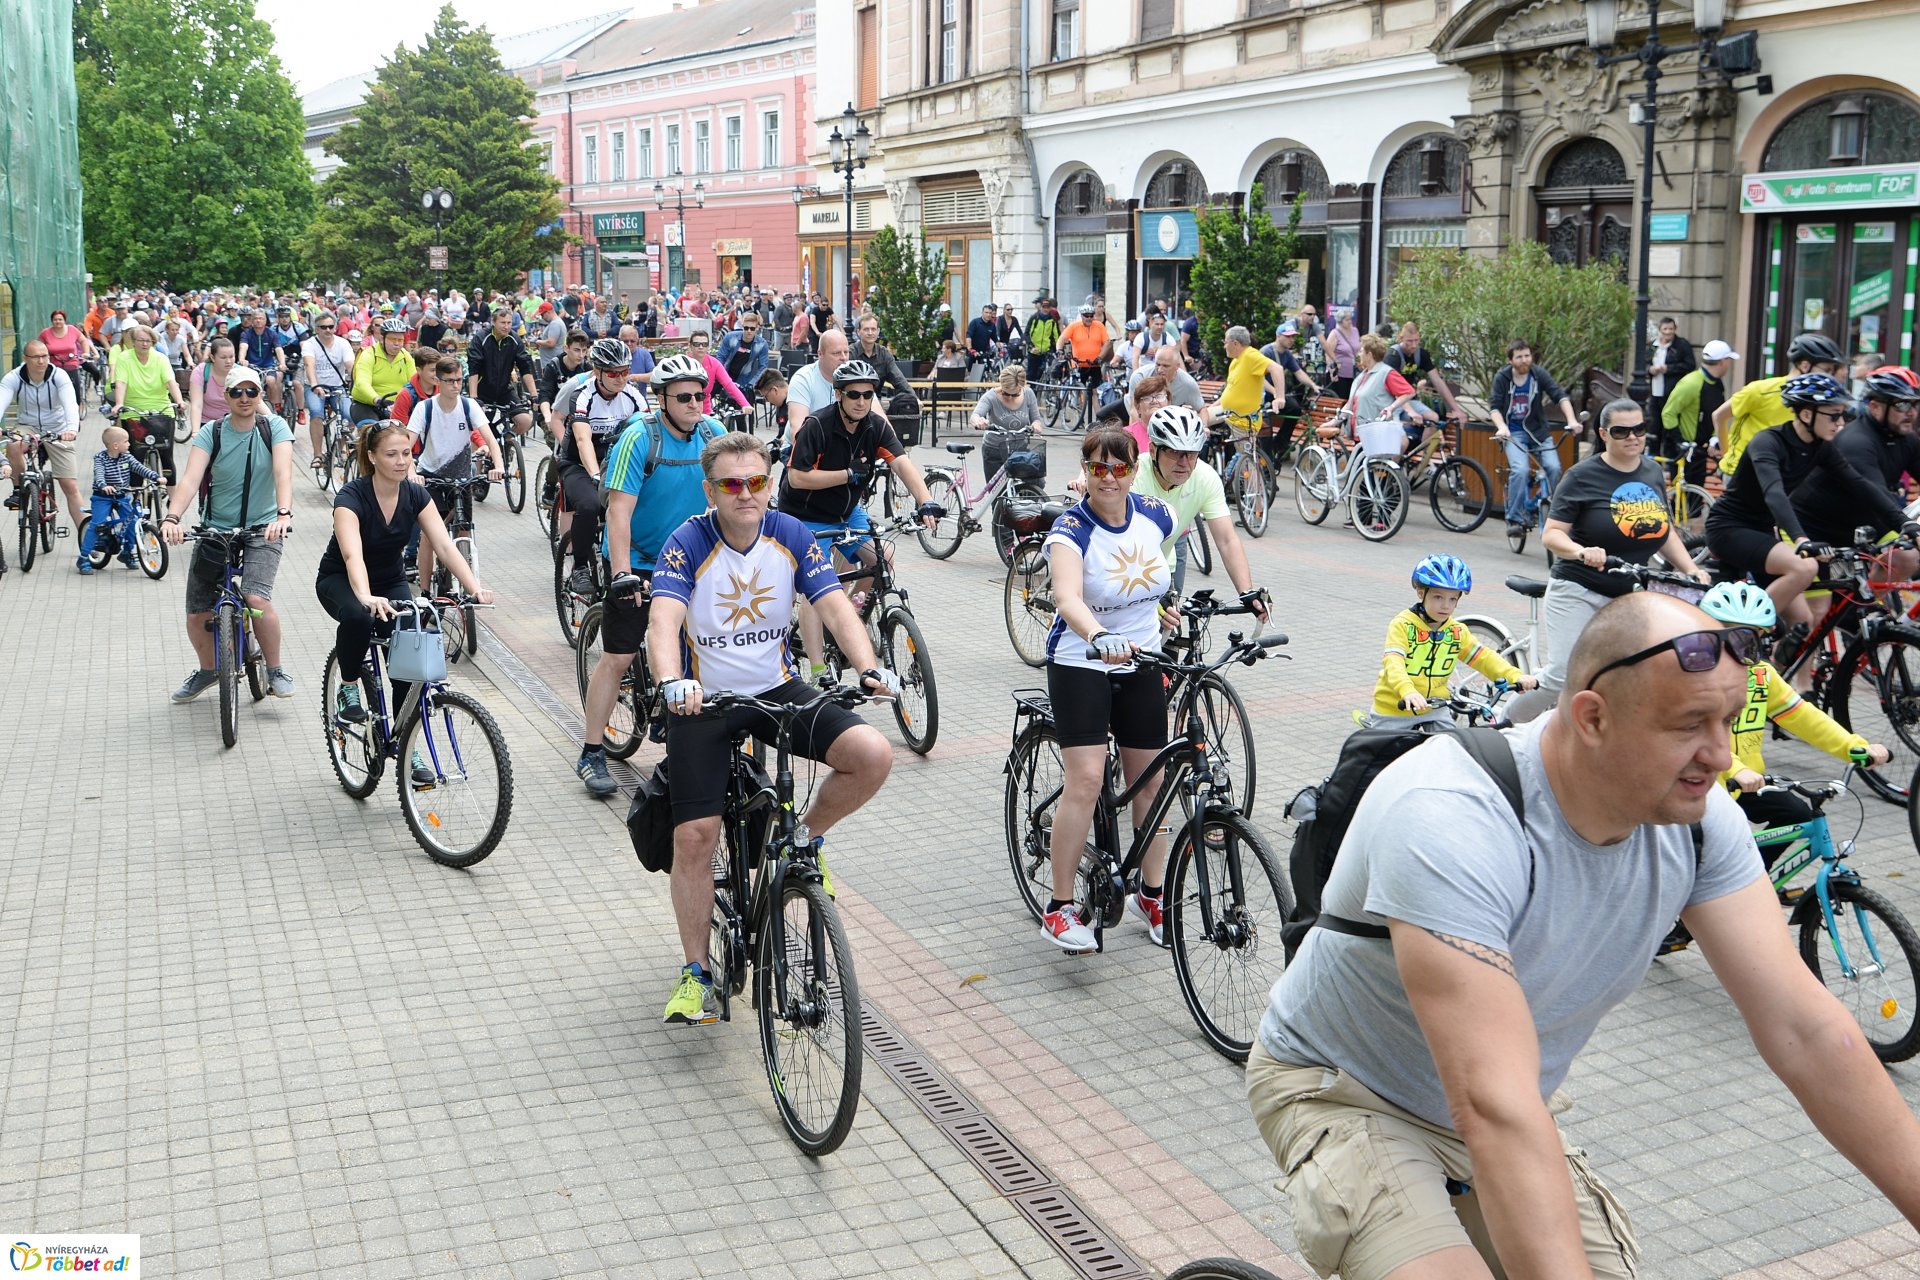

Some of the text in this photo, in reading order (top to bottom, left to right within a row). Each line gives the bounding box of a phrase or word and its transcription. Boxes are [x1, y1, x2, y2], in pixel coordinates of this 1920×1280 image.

[1827, 181, 1872, 194] Centrum
[1877, 176, 1912, 193] FDF
[598, 214, 638, 231] NYÍRSÉG
[812, 212, 840, 223] MARELLA
[458, 422, 466, 430] B
[807, 567, 821, 578] UFS
[1092, 604, 1122, 613] UFS
[697, 626, 788, 649] UFS GROUP
